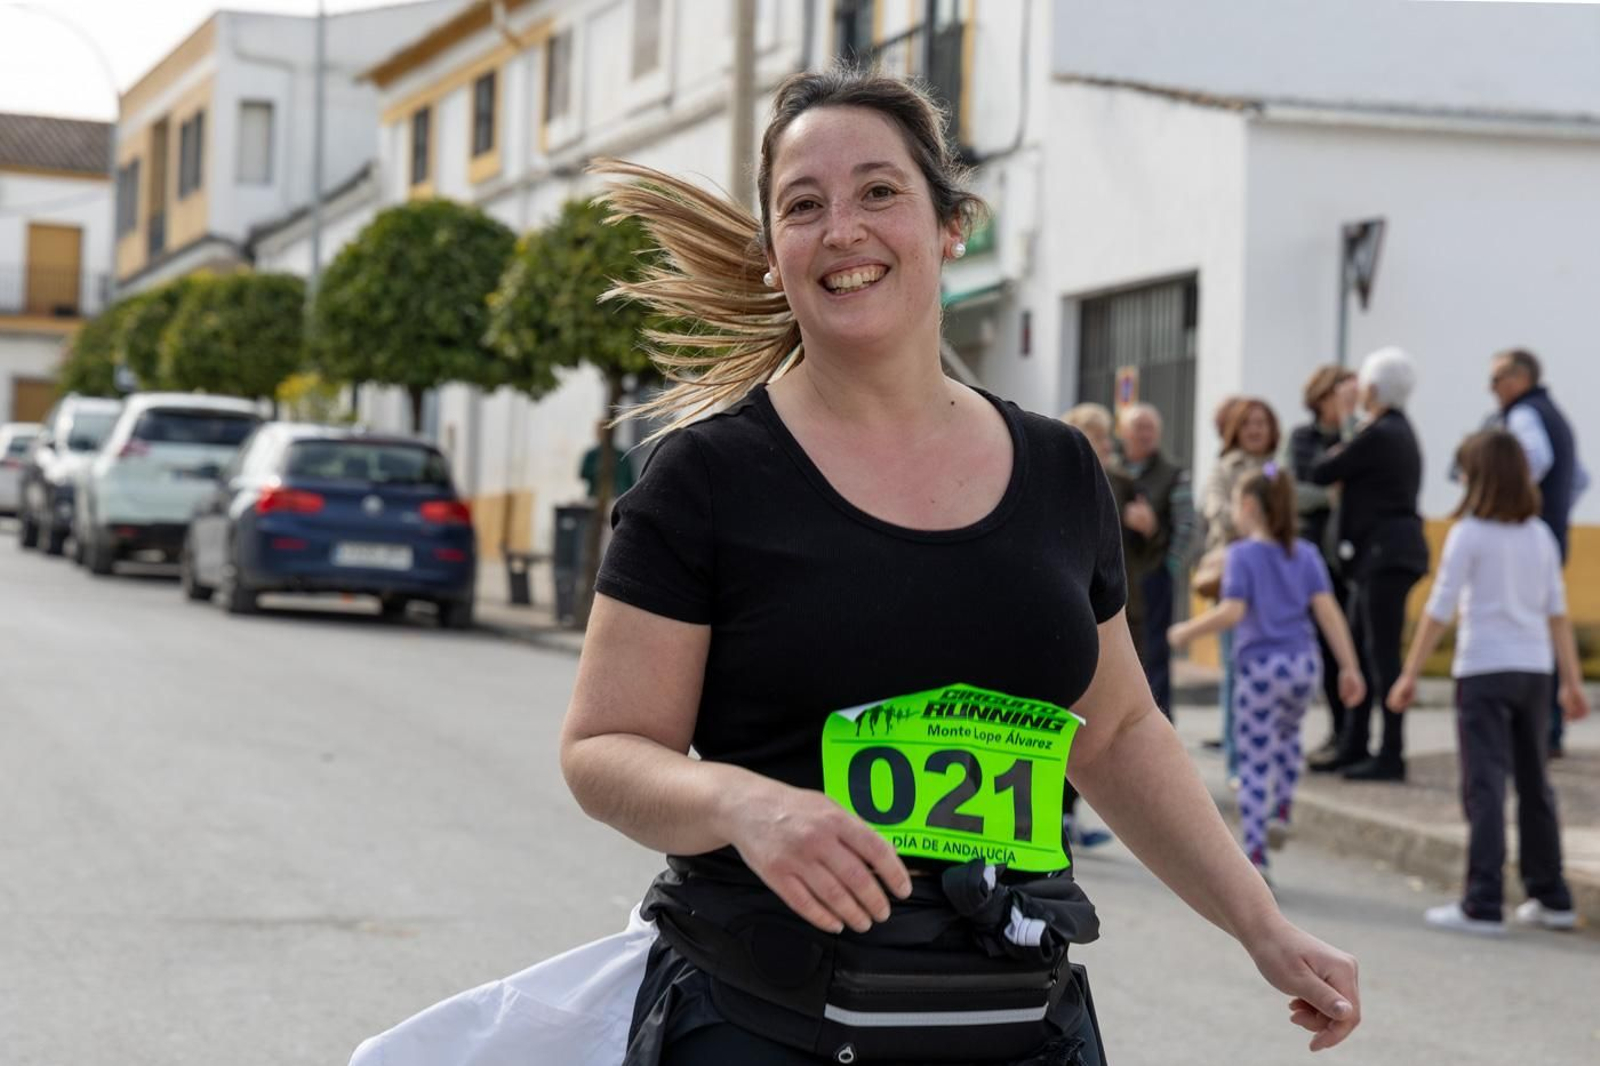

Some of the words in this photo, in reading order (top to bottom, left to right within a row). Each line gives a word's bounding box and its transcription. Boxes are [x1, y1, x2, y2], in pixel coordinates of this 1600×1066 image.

[922, 700, 1067, 734] RUNNING
[927, 724, 971, 738] Monte
[974, 727, 1002, 744] Lope
[1005, 730, 1053, 750] Álvarez
[847, 745, 1034, 844] 021
[892, 834, 917, 849] DÍA
[922, 836, 938, 851] DE
[942, 841, 1017, 863] ANDALUCÍA
